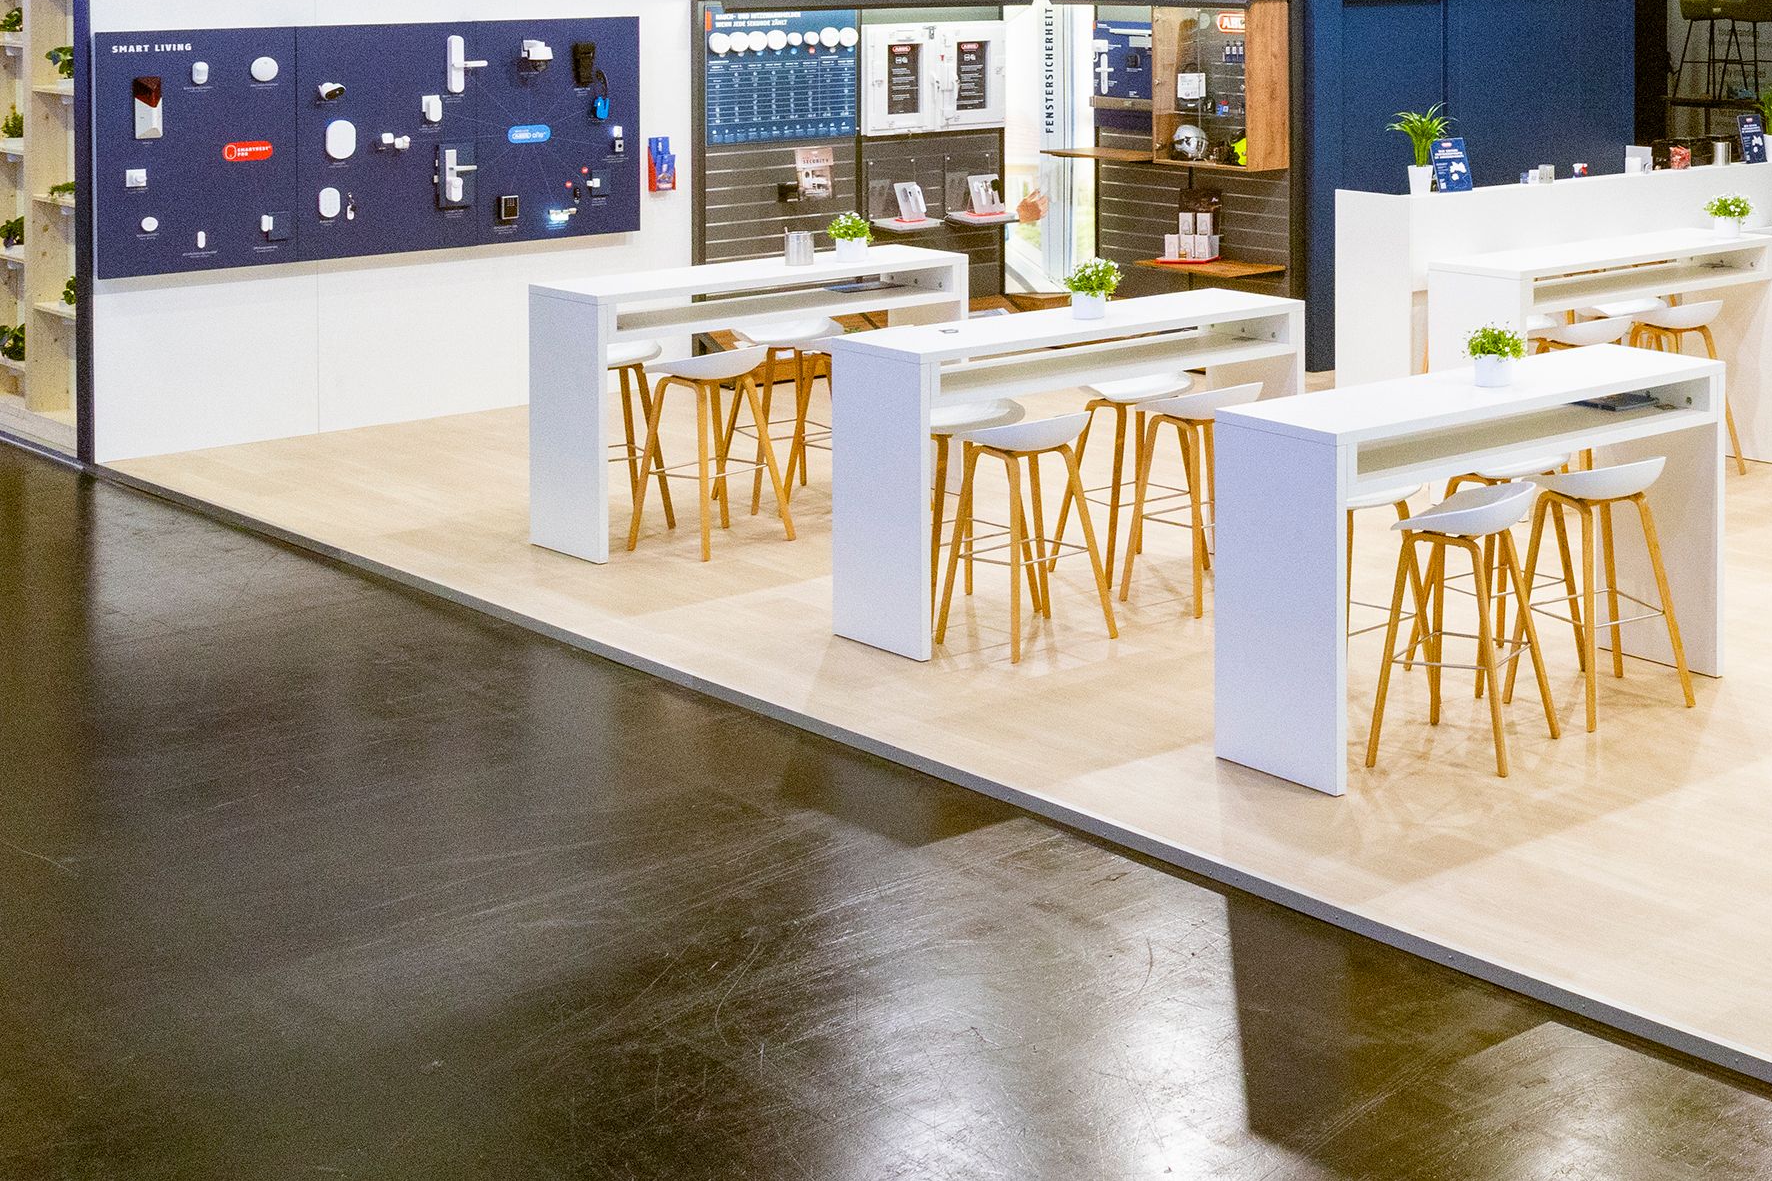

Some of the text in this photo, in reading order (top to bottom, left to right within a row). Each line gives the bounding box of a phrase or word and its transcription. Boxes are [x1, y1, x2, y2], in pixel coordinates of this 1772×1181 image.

[112, 43, 193, 54] SMART LIVING
[1045, 8, 1055, 134] FENSTERSICHERHEIT
